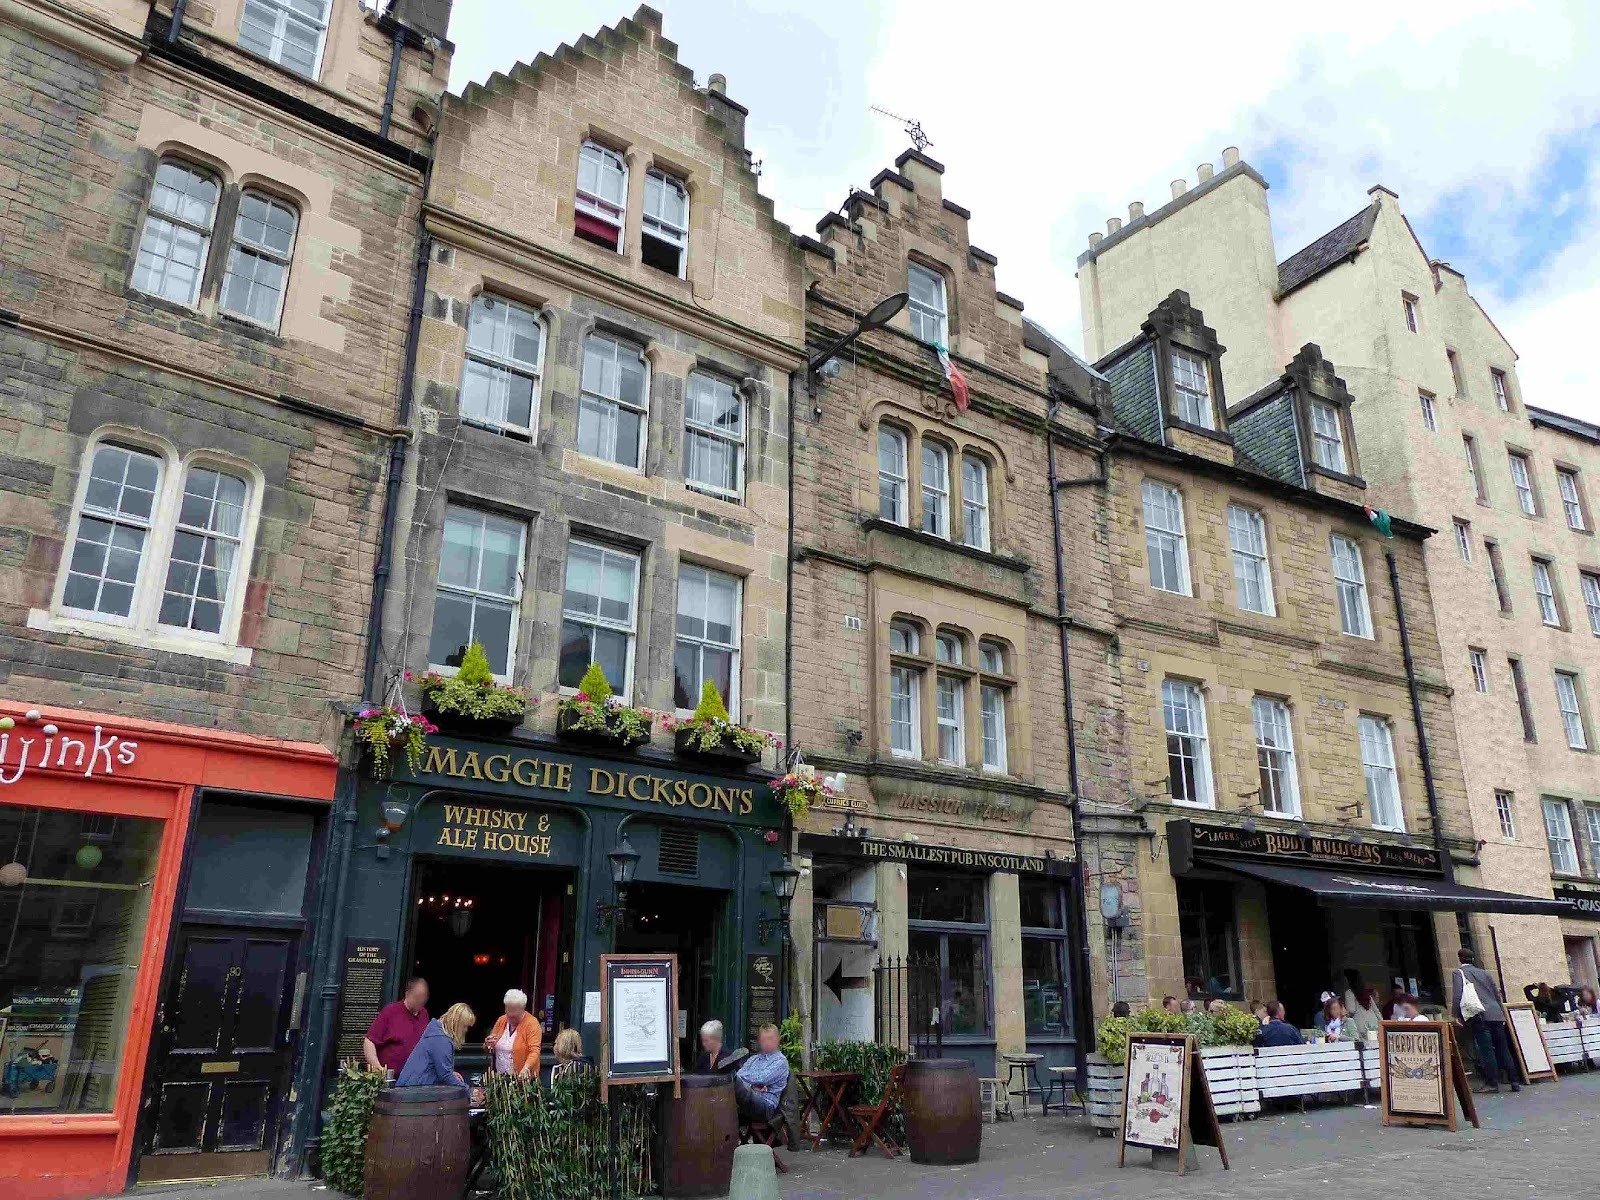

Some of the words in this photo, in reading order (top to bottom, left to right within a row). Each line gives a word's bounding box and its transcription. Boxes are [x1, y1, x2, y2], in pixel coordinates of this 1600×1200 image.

[421, 746, 573, 793] MAGGIE
[587, 767, 753, 816] DICKSON'S
[443, 804, 528, 831] WHISKY
[537, 813, 551, 832] &
[436, 827, 479, 851] ALE
[483, 831, 552, 858] HOUSE
[860, 842, 887, 857] THE
[888, 844, 951, 863] SMALLEST
[951, 852, 973, 865] PUB
[974, 853, 987, 866] IN
[987, 855, 1044, 872] SCOTLAND
[1266, 834, 1306, 854] BIDDY
[1311, 839, 1382, 865] MULLIGANS
[1388, 1034, 1414, 1053] MARDI
[1417, 1034, 1437, 1054] GRAS
